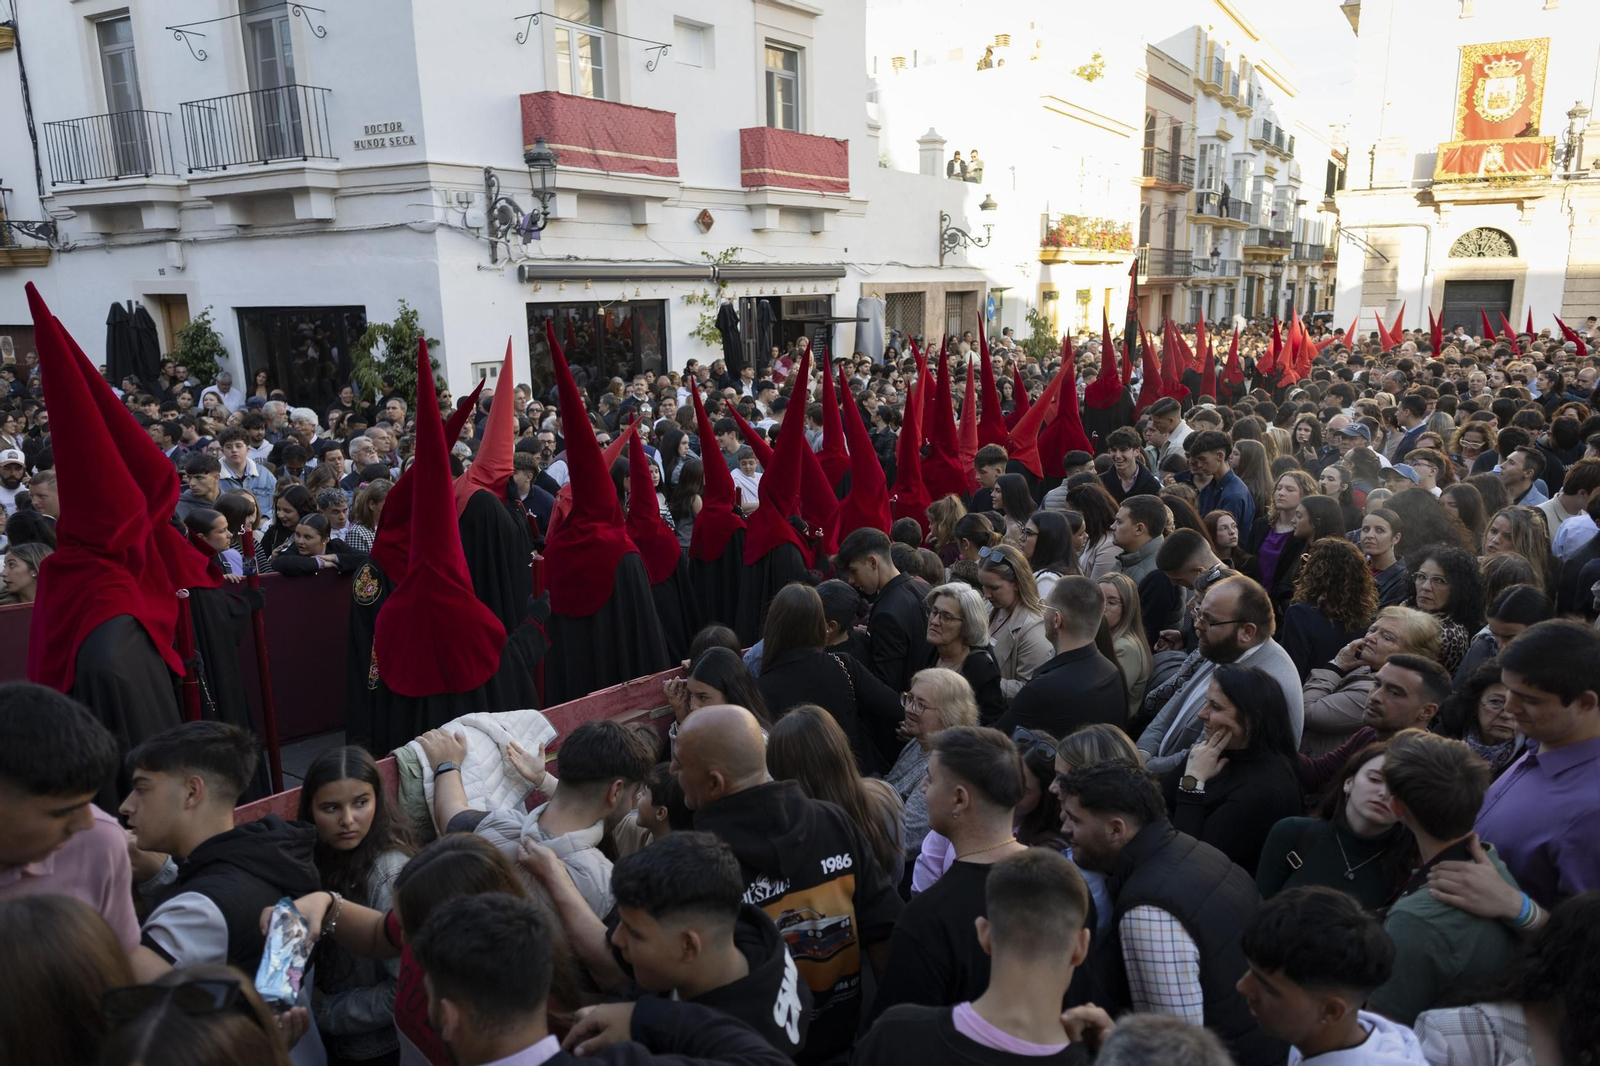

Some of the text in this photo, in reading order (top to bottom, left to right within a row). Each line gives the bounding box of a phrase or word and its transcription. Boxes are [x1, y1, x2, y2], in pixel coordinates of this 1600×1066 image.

[364, 121, 402, 133] DOCTOR
[389, 135, 415, 146] SECA
[820, 853, 853, 875] 1986
